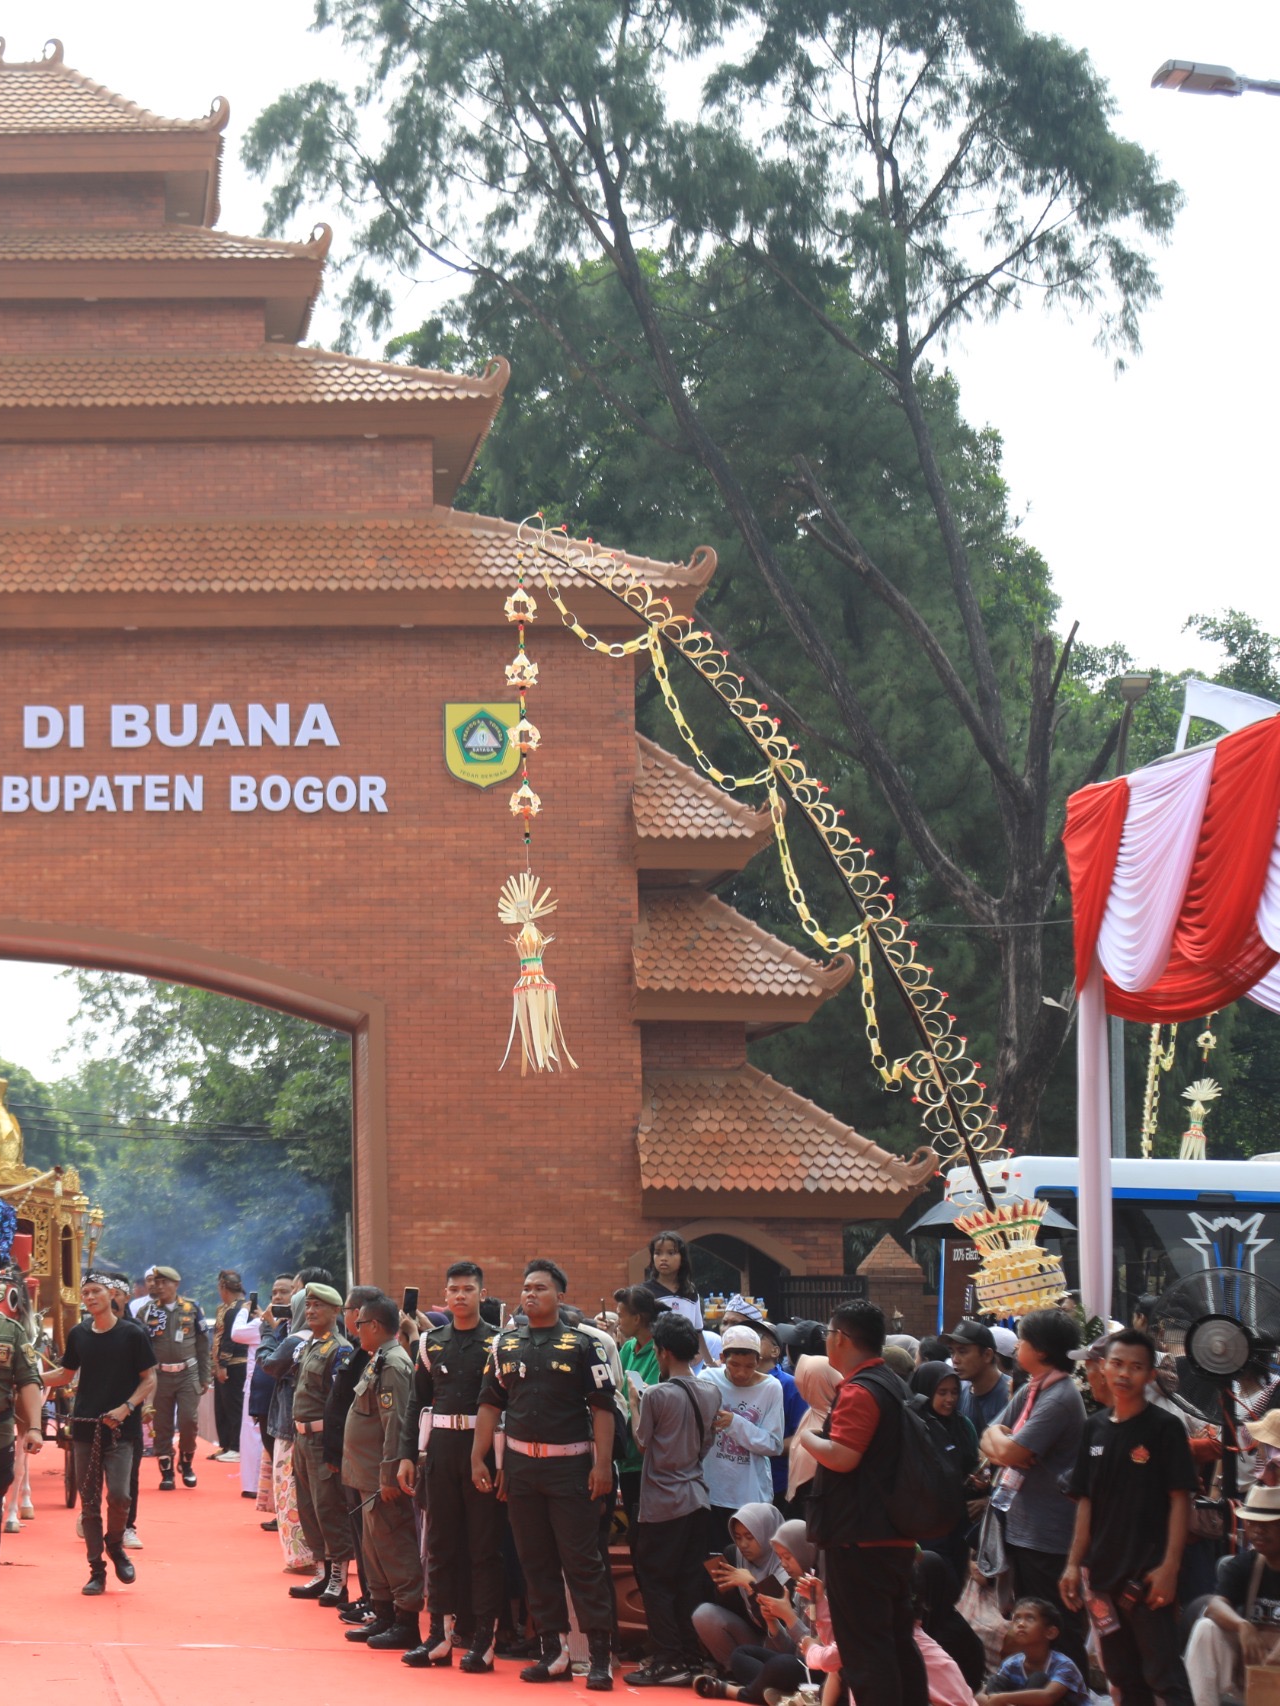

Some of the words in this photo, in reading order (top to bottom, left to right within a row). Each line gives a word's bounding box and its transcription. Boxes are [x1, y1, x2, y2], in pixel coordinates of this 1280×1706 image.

[23, 705, 85, 749] DI
[110, 703, 341, 748] BUANA
[230, 774, 389, 813] BOGOR
